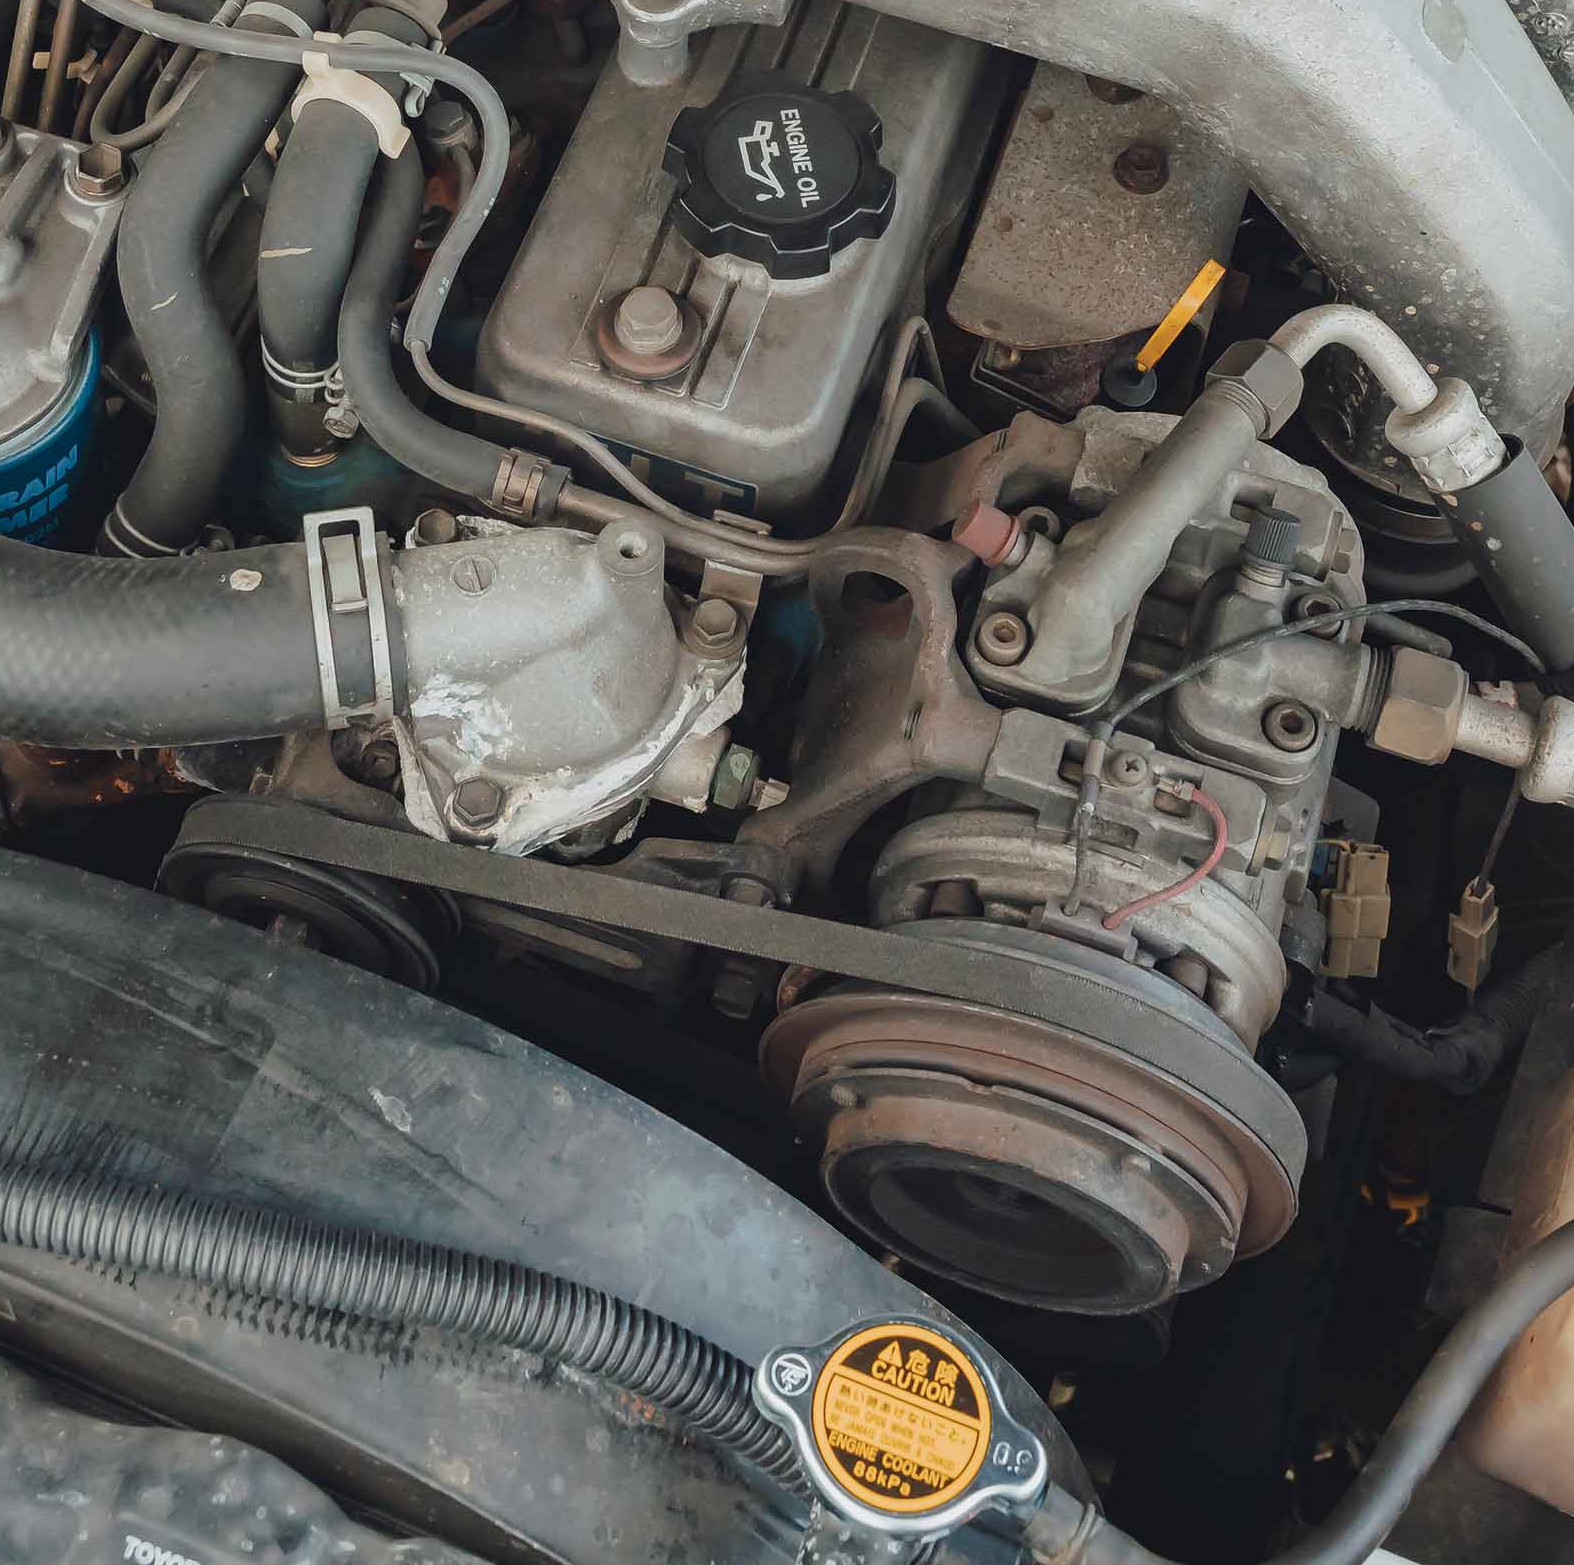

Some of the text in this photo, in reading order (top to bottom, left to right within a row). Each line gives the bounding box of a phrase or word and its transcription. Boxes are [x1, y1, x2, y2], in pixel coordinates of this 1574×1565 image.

[780, 108, 821, 208] ENGINE OIL
[871, 1360, 956, 1407] CAUTION
[905, 1348, 960, 1386] 危険
[827, 1430, 950, 1490] ENGINE COOLANT
[852, 1459, 912, 1497] 88kPa
